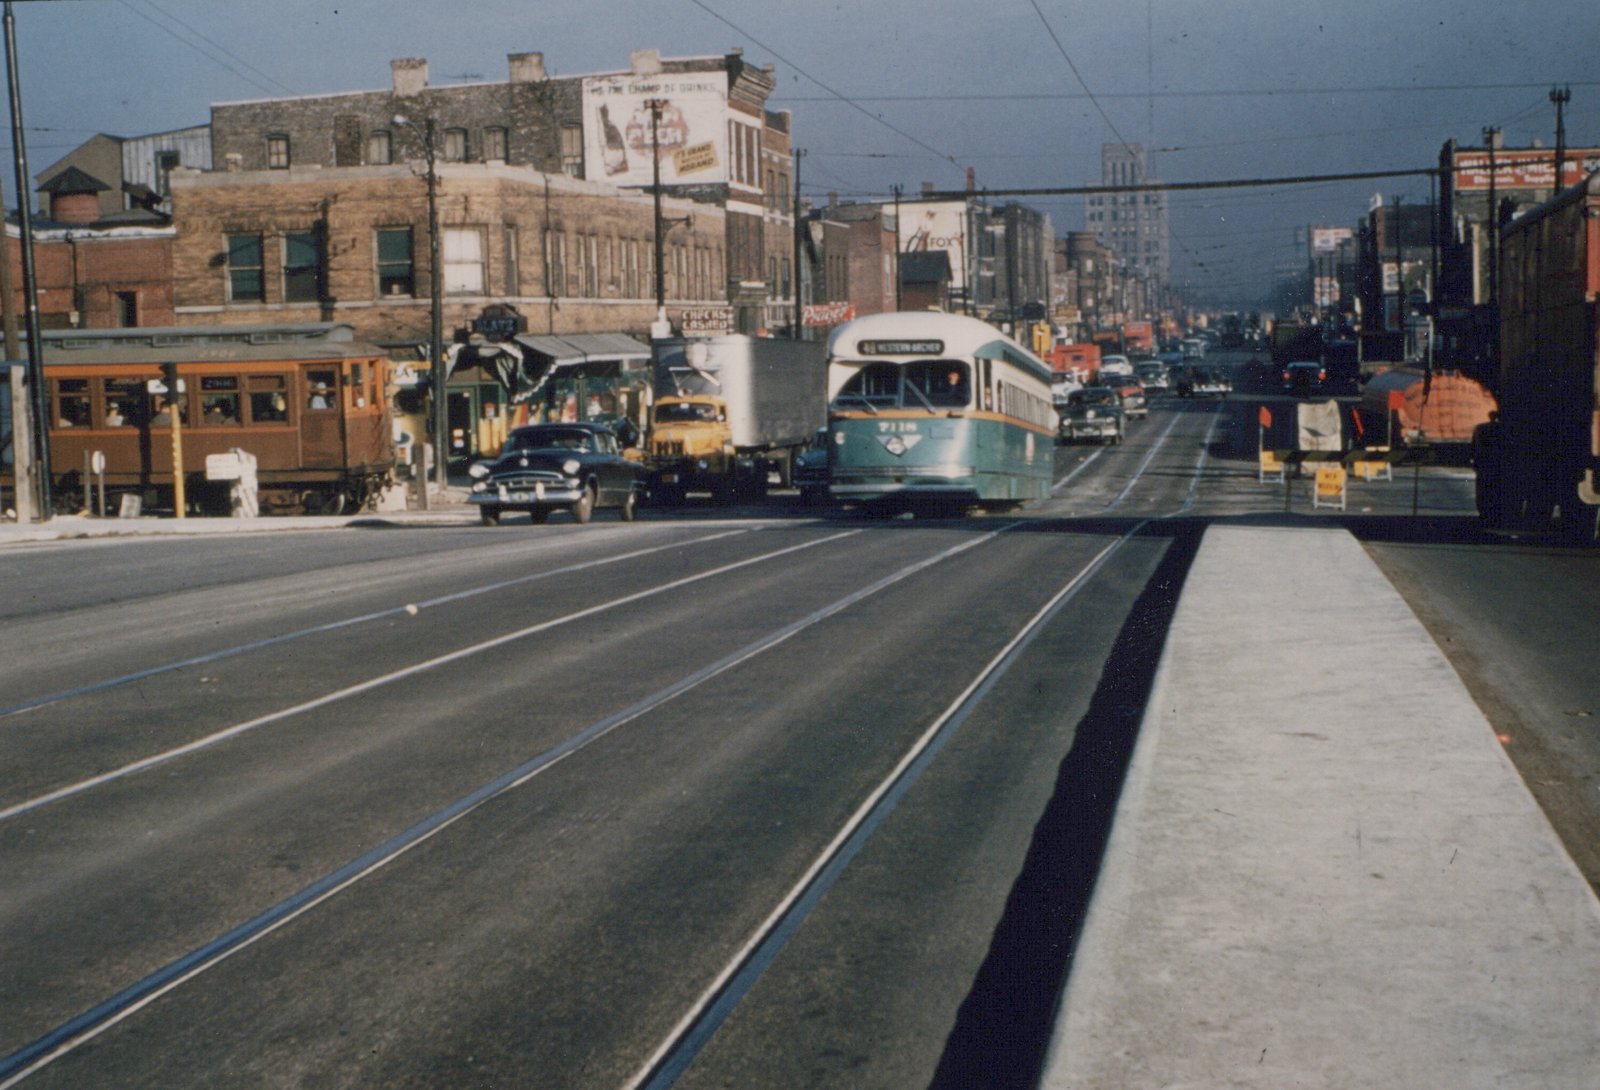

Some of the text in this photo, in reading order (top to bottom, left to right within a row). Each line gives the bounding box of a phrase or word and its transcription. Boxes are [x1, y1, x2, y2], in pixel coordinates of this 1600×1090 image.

[628, 83, 660, 95] CHAMP
[682, 310, 728, 320] CHECKS
[682, 320, 728, 330] CASHED
